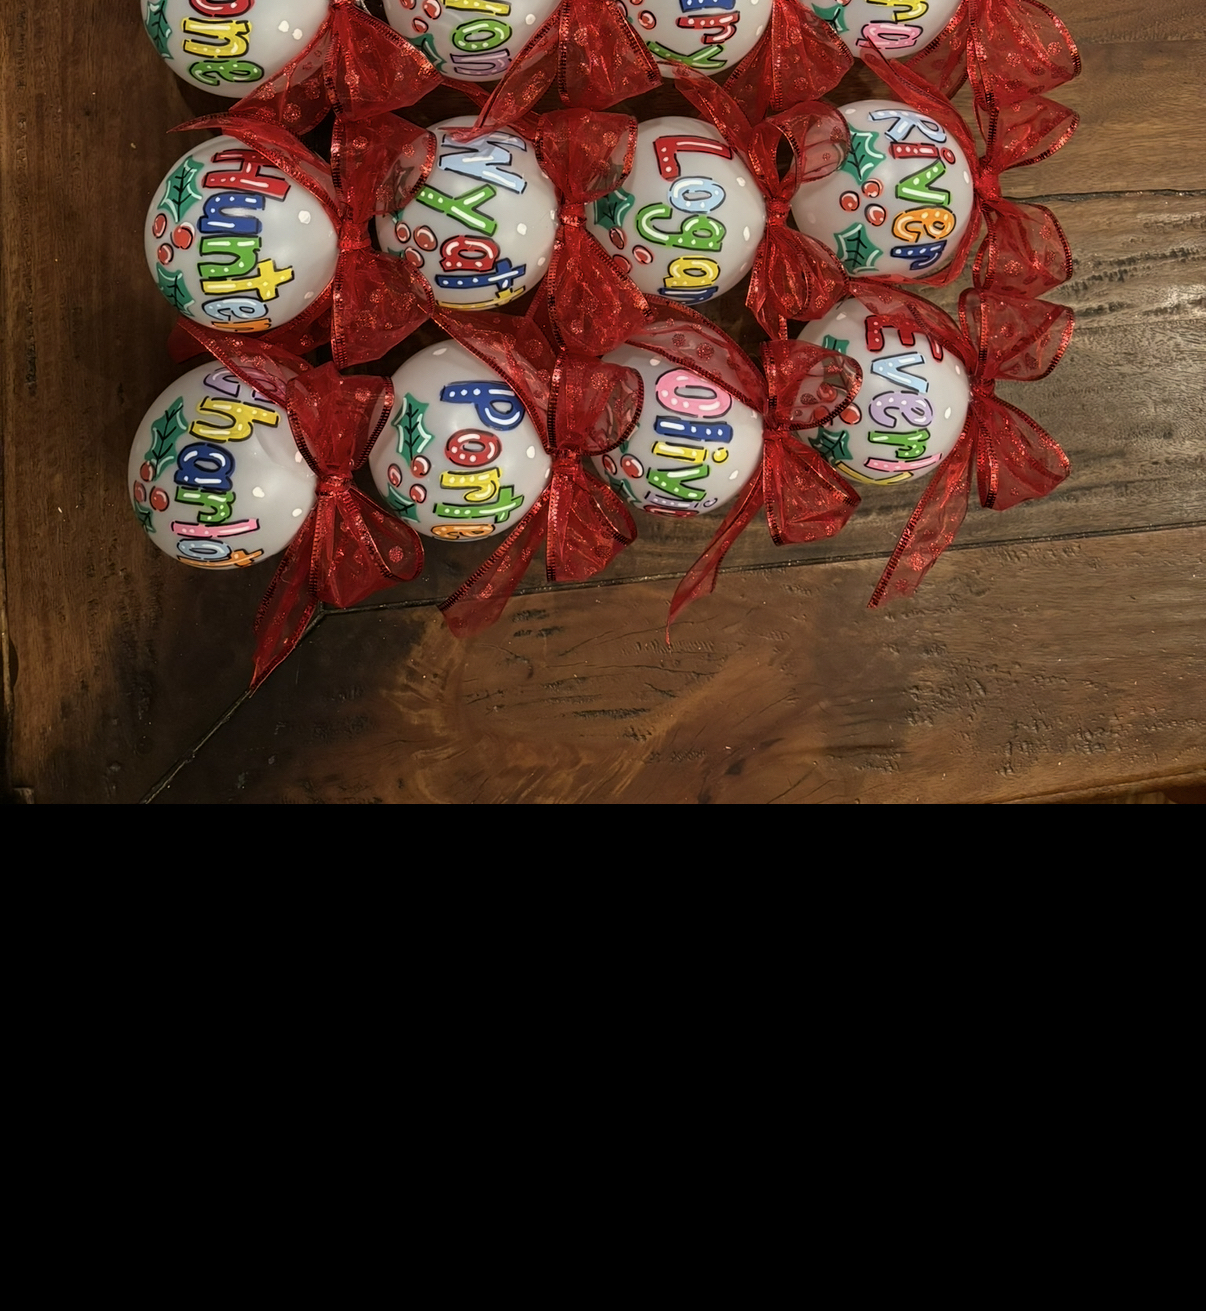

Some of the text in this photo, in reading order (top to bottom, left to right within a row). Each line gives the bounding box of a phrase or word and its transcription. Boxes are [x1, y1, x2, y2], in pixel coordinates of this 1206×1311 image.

[196, 148, 295, 334] Hunter
[415, 131, 528, 309] Wyatt
[636, 134, 733, 305] Logan
[868, 109, 957, 270] River
[835, 314, 944, 486] Everly
